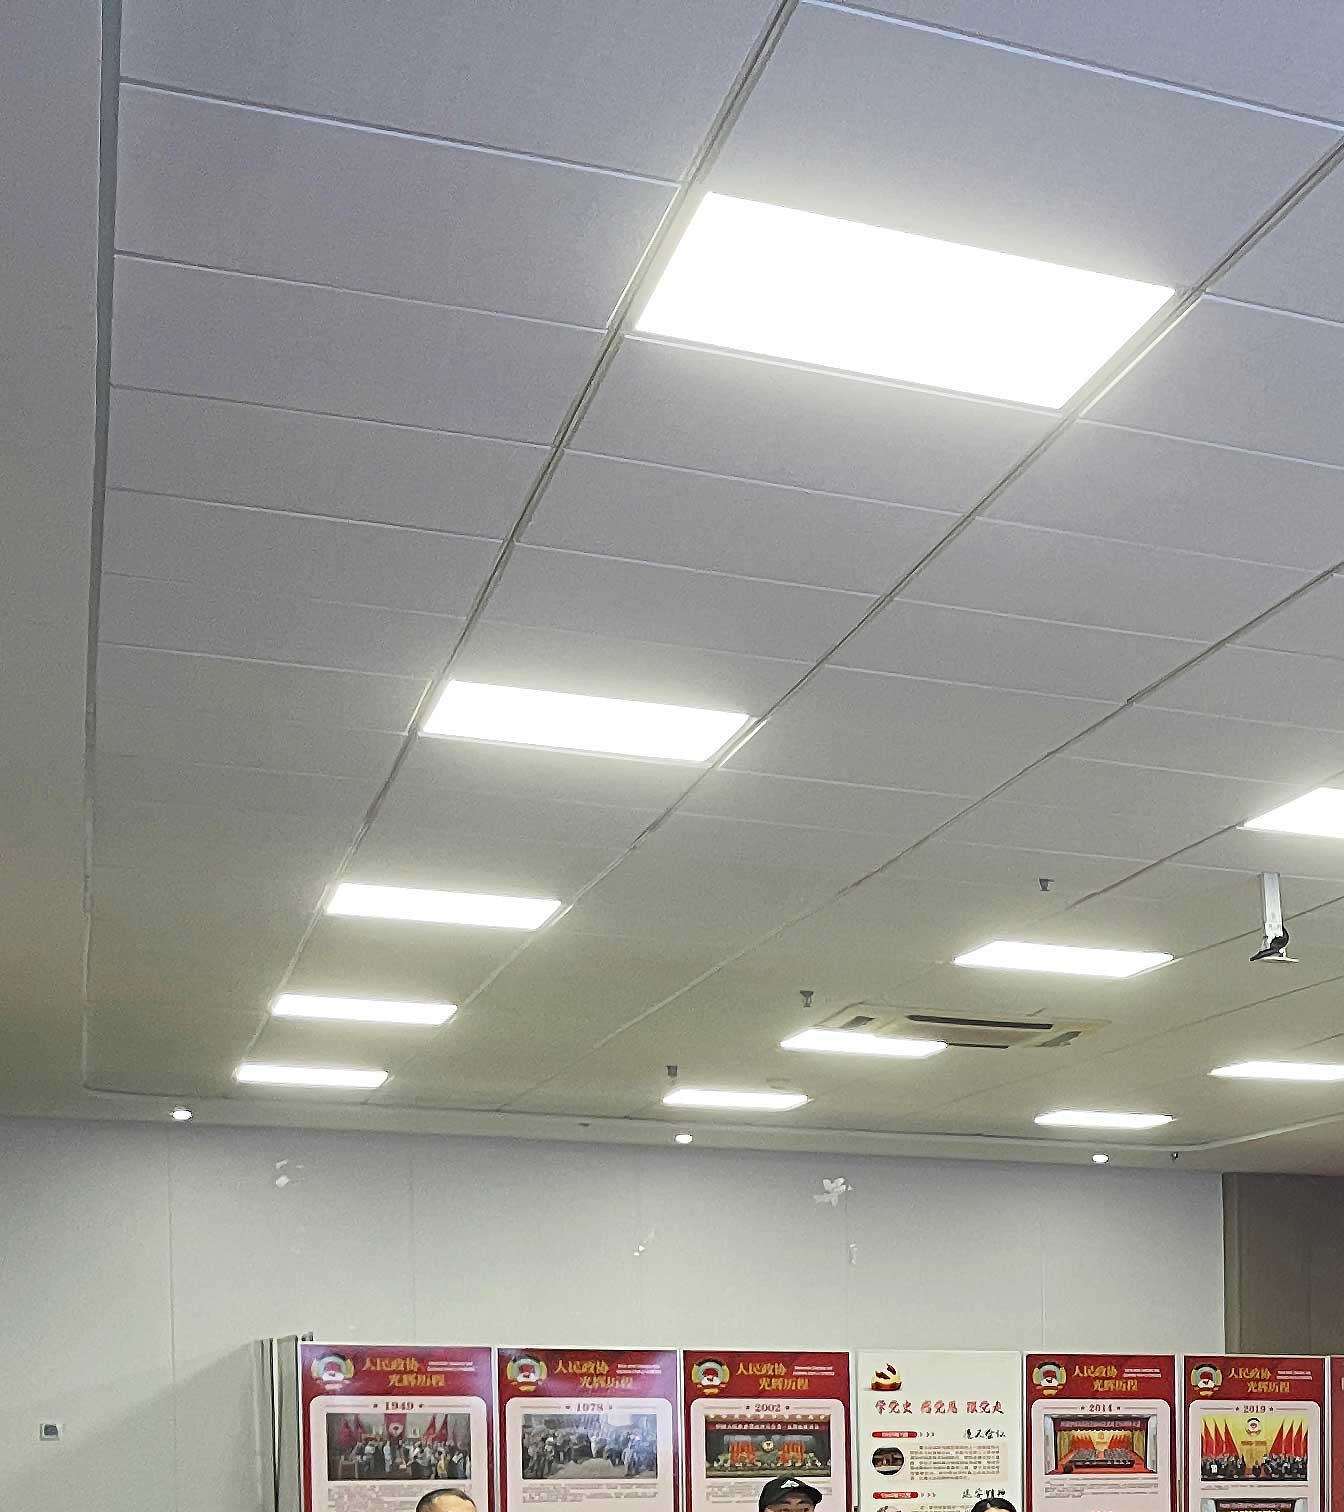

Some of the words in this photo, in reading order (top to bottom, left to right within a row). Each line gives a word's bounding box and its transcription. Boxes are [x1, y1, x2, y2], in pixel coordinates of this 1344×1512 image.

[384, 1401, 414, 1411] 1949
[754, 1403, 781, 1413] 2002
[1088, 1403, 1113, 1413] 2014
[1243, 1404, 1266, 1414] 2019
